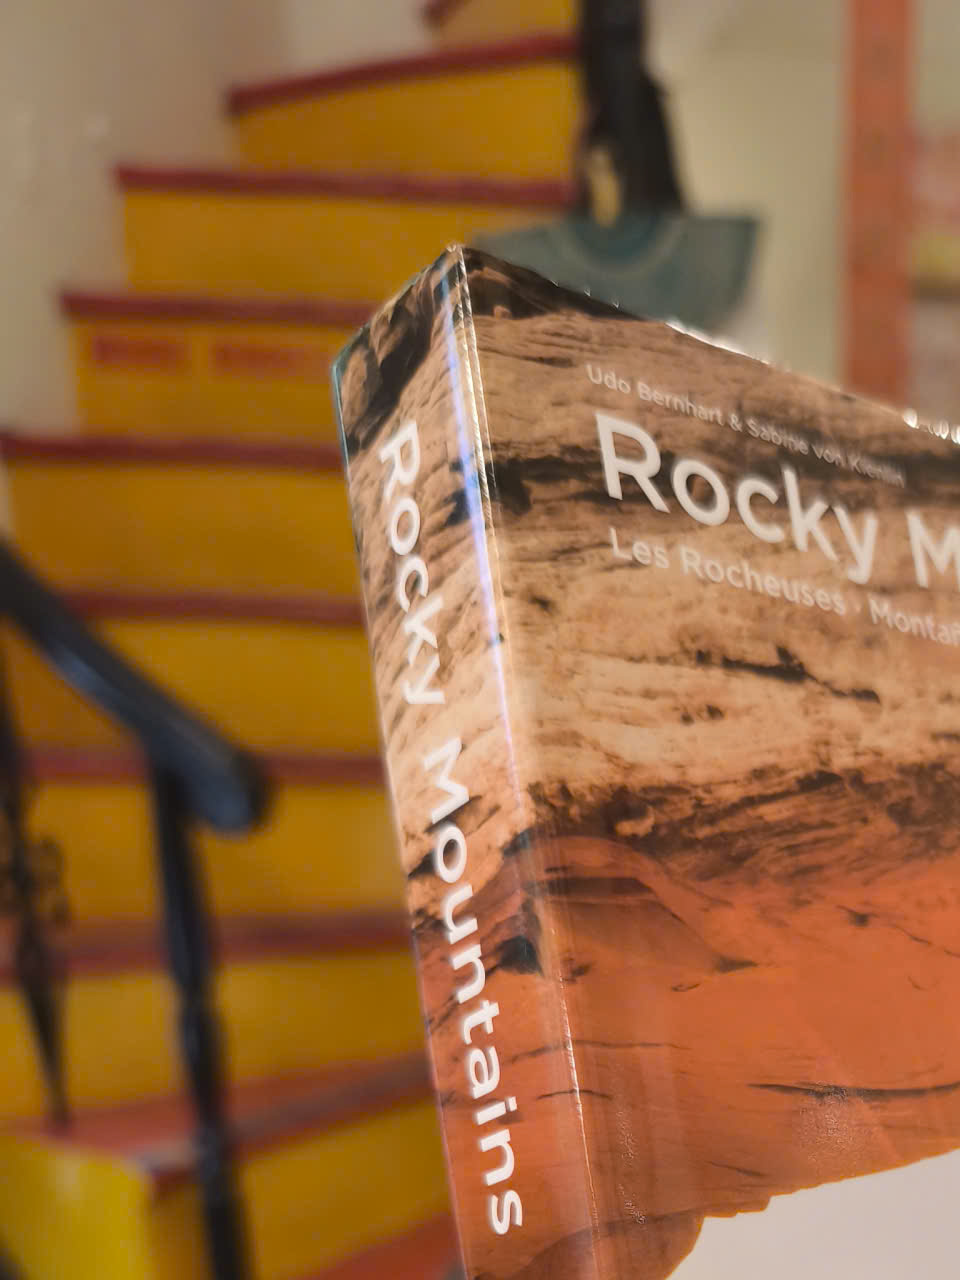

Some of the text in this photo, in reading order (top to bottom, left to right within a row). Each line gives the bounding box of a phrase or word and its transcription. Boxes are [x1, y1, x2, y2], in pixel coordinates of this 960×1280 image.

[585, 363, 631, 395] Udo
[637, 381, 724, 427] Bernhart
[728, 412, 744, 433] &
[594, 410, 878, 585] Rocky
[609, 525, 670, 569] Les
[680, 544, 848, 616] Rocheuses
[379, 420, 523, 1236] Rocky Mountains
